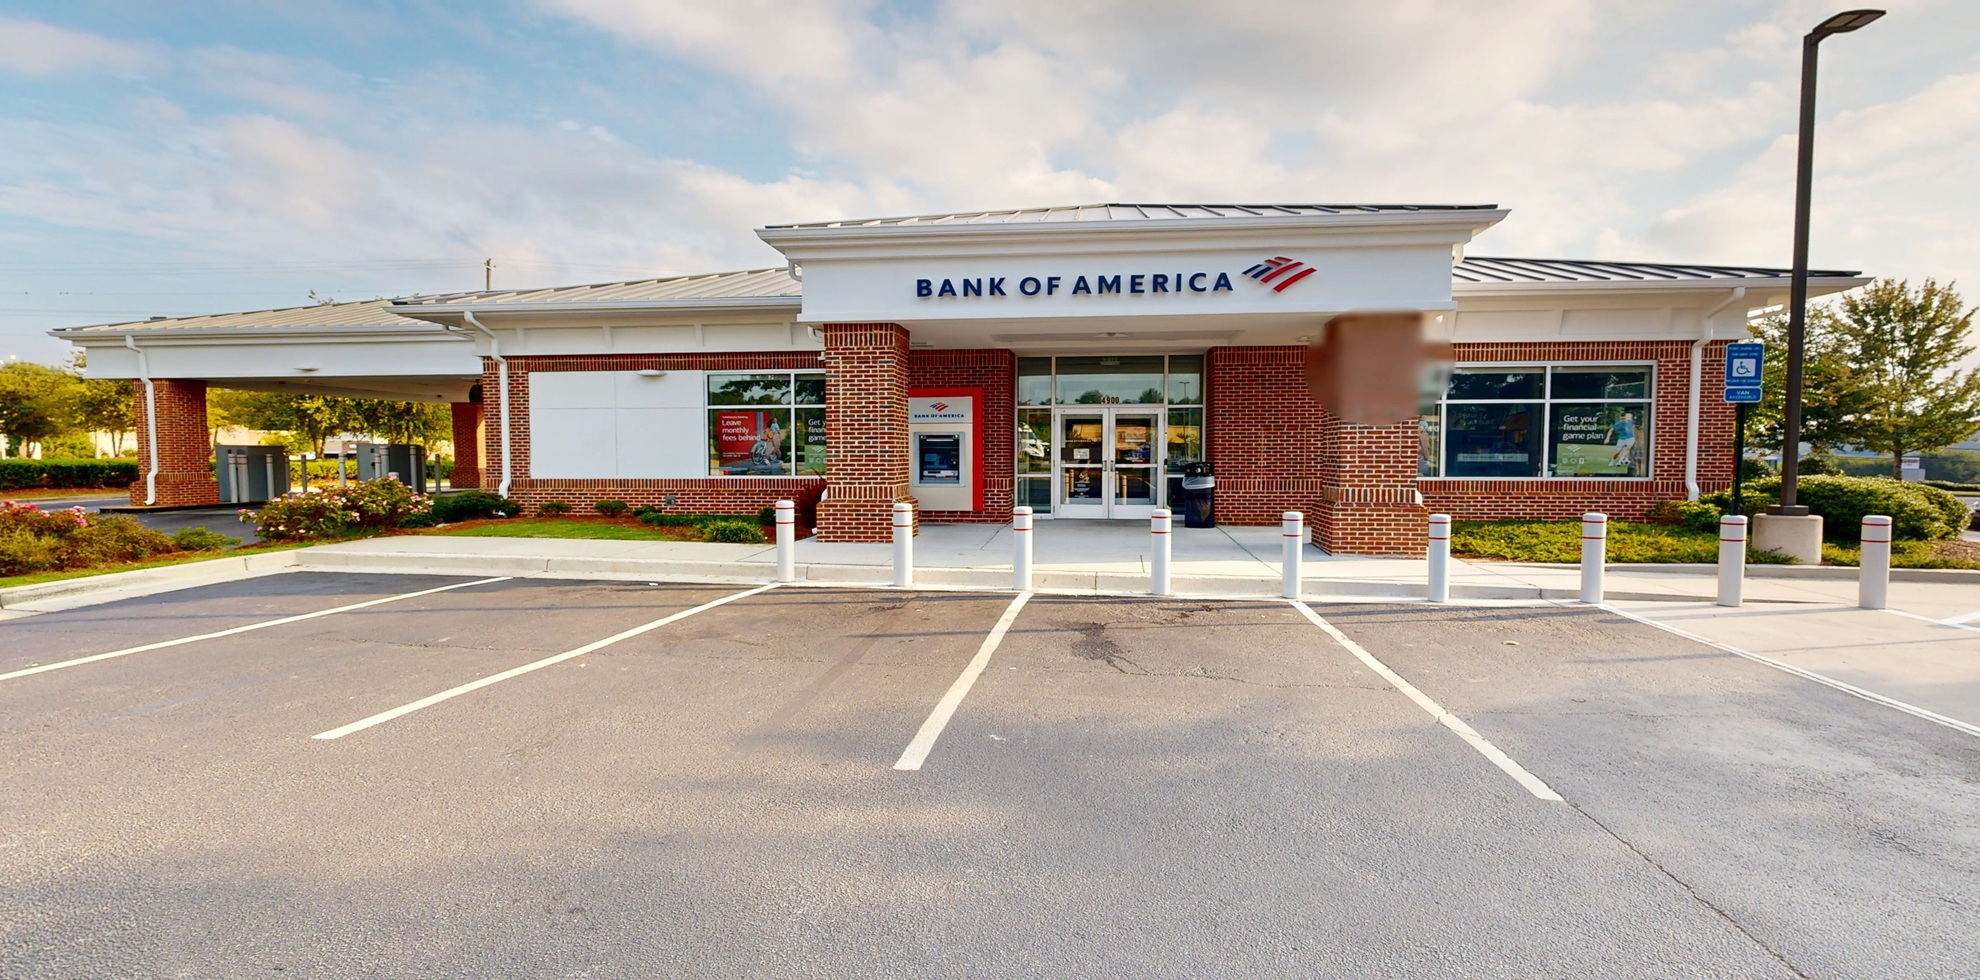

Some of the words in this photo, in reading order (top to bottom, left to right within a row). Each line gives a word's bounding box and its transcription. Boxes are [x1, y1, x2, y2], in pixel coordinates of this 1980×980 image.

[916, 278, 1007, 298] BANK
[1019, 276, 1062, 296] OF
[1071, 272, 1234, 295] AMERICA
[1101, 396, 1120, 404] 4900
[808, 418, 821, 426] Get
[1563, 415, 1578, 423] Get
[1580, 415, 1599, 424] your
[1563, 423, 1597, 431] financial
[1562, 432, 1586, 441] game
[1586, 432, 1604, 440] plan
